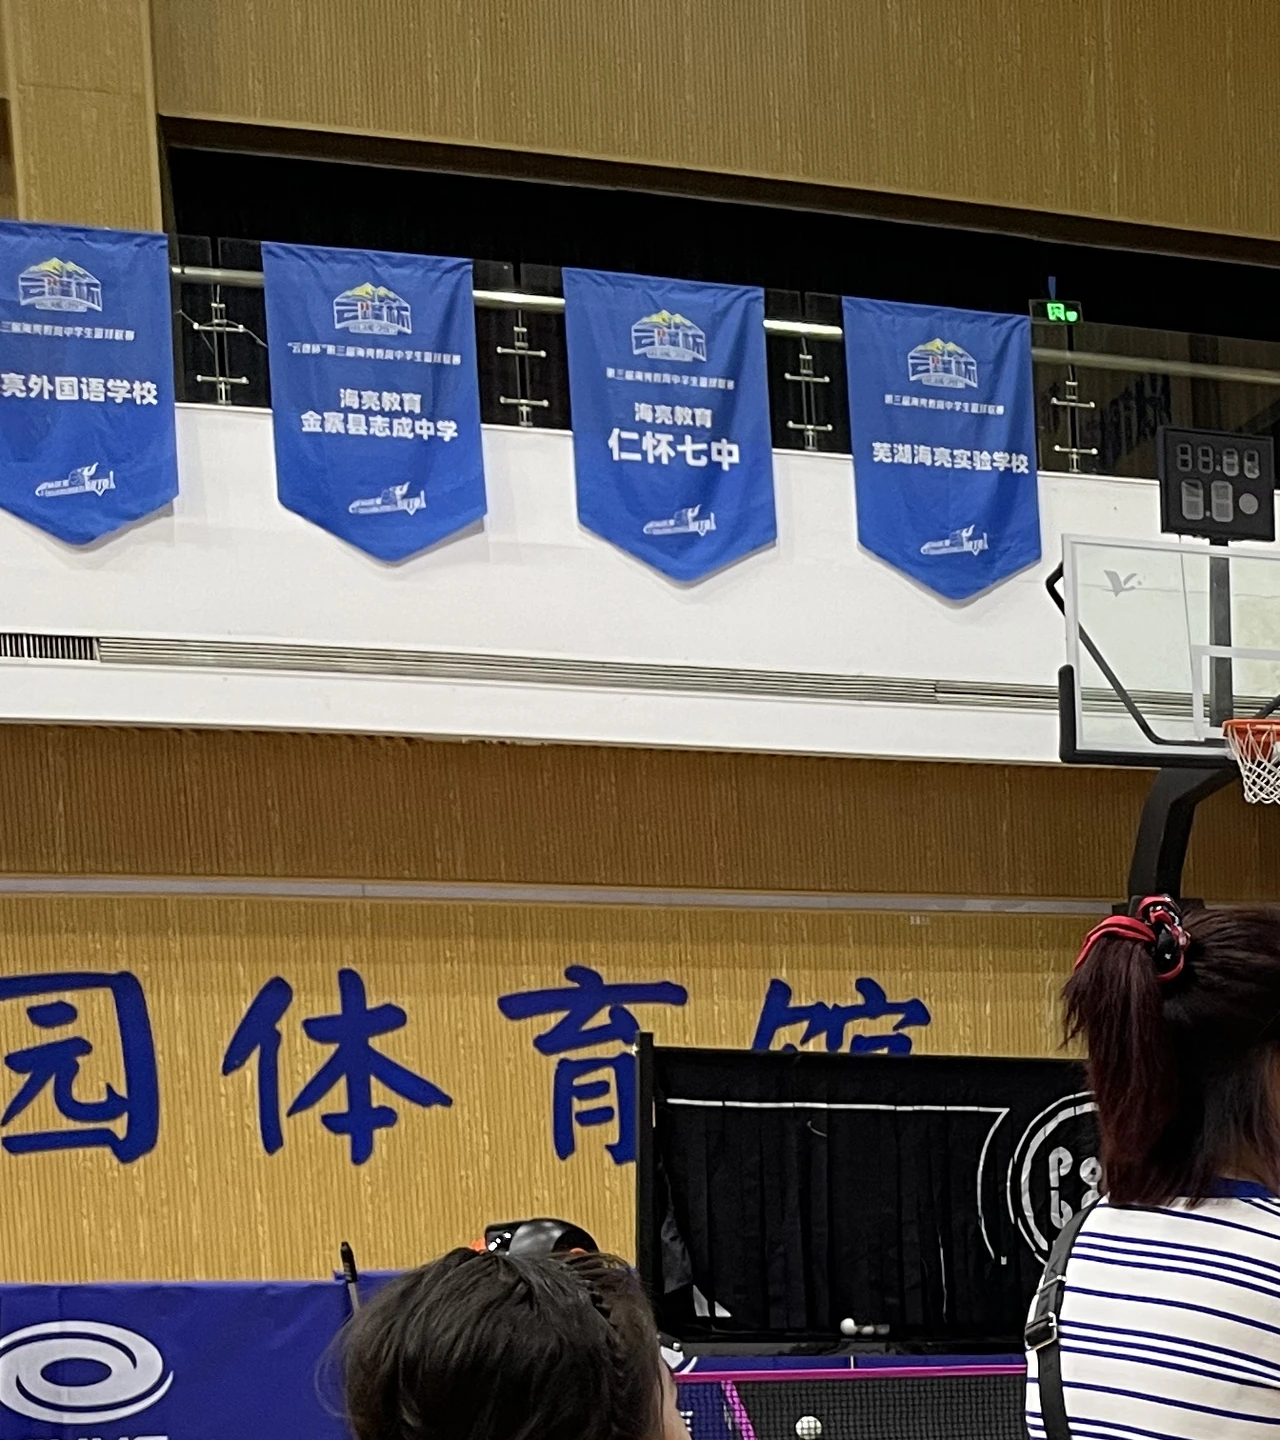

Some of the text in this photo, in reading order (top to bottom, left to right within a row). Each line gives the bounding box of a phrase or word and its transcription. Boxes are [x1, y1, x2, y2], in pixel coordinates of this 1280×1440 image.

[339, 388, 422, 414] 海亮教育
[634, 402, 712, 428] 海亮教育
[301, 410, 459, 442] 金寨县志成中学
[608, 427, 740, 471] 仁怀七中
[872, 441, 1030, 474] 芜湖海亮实验学校
